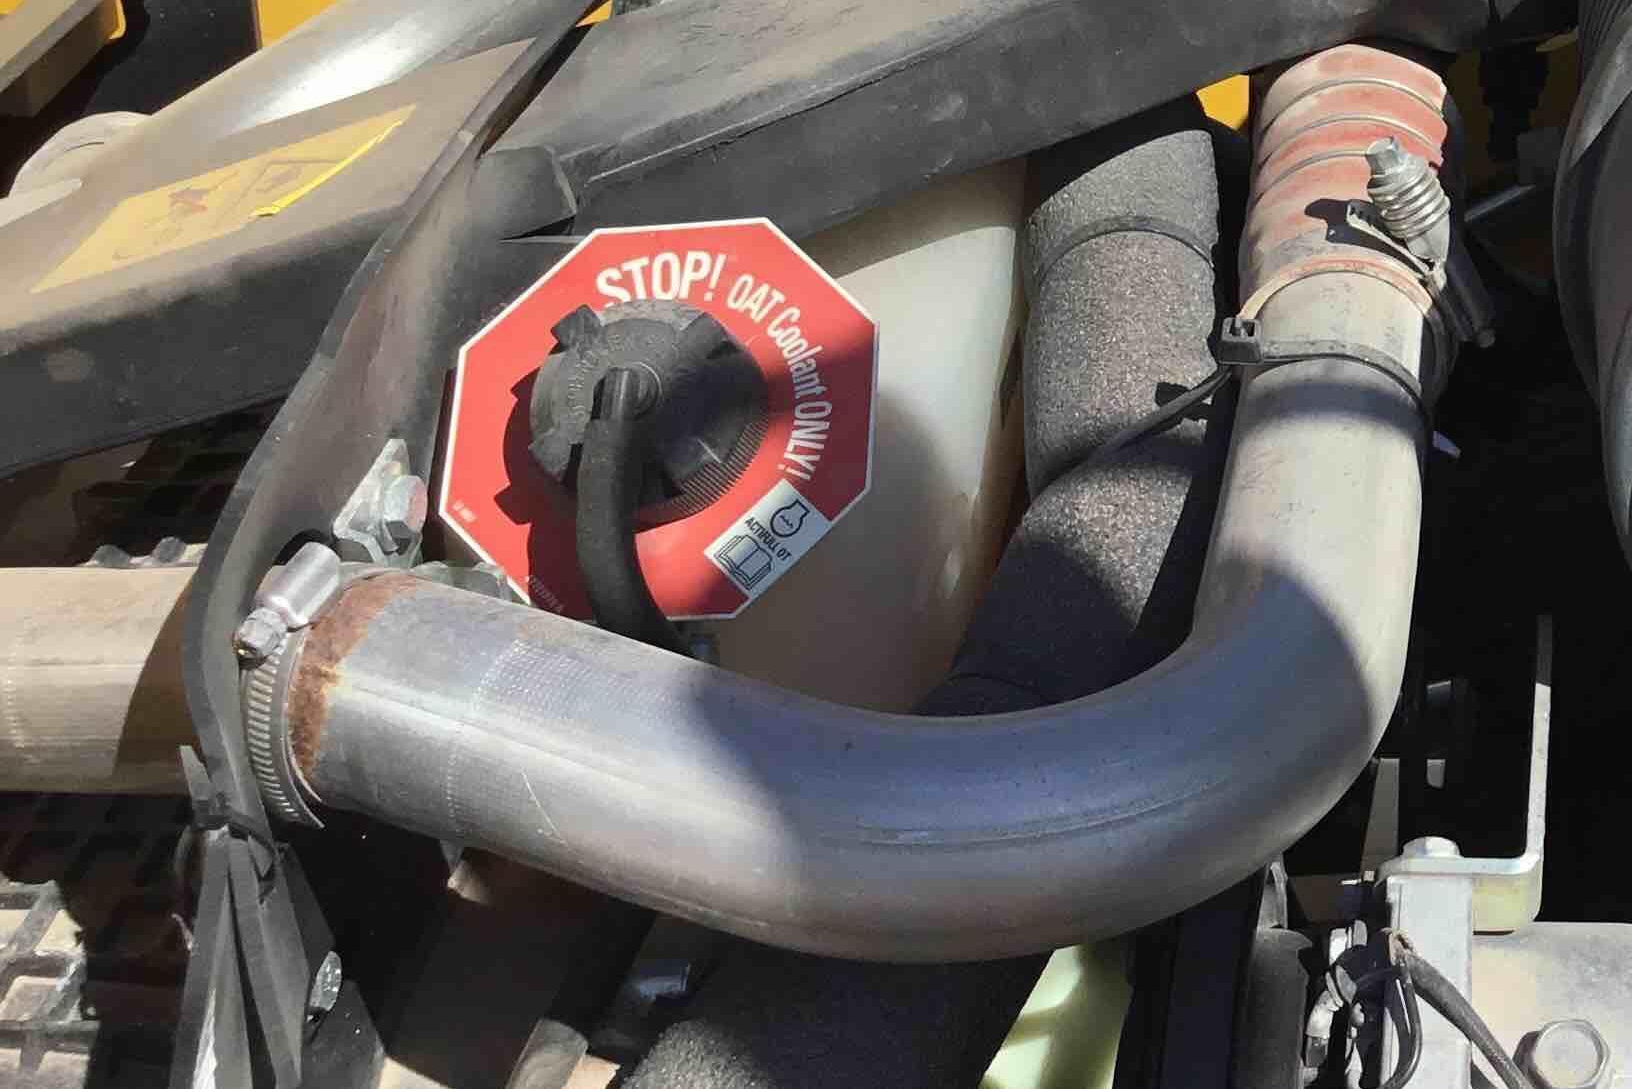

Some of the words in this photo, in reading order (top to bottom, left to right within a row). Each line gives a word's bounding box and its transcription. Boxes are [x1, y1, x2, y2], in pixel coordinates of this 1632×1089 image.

[596, 250, 727, 308] STOP!
[726, 274, 786, 323] OAT
[767, 306, 828, 400] Coolant
[777, 400, 833, 481] ONLY!
